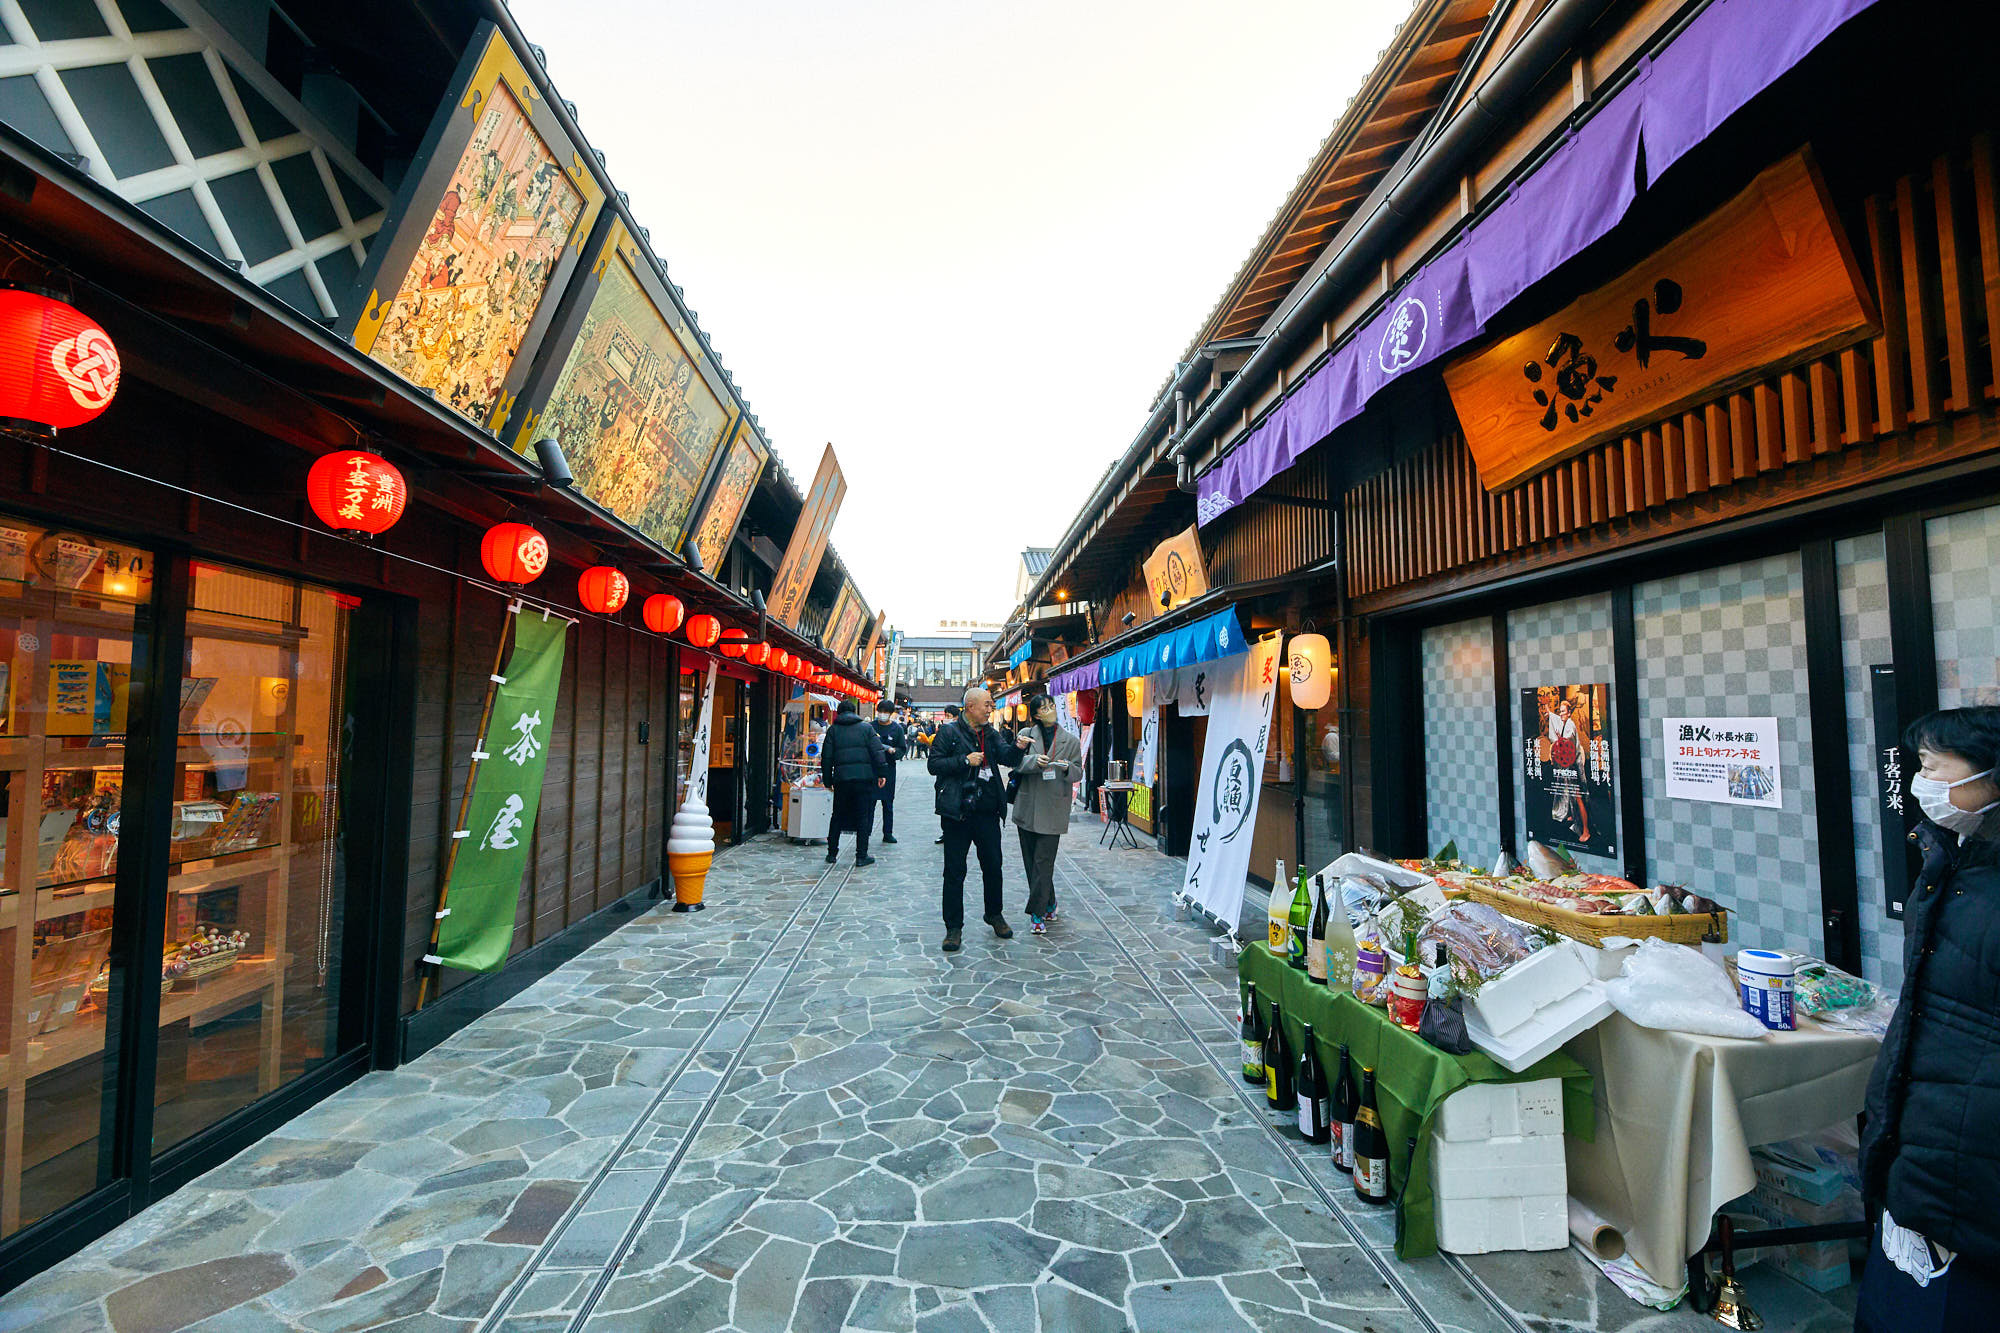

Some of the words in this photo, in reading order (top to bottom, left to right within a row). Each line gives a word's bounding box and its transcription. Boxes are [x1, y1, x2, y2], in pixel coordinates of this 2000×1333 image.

[371, 473, 396, 513] 豊洲
[479, 709, 542, 852] 茶屋
[1882, 746, 1904, 816] 千客万来。
